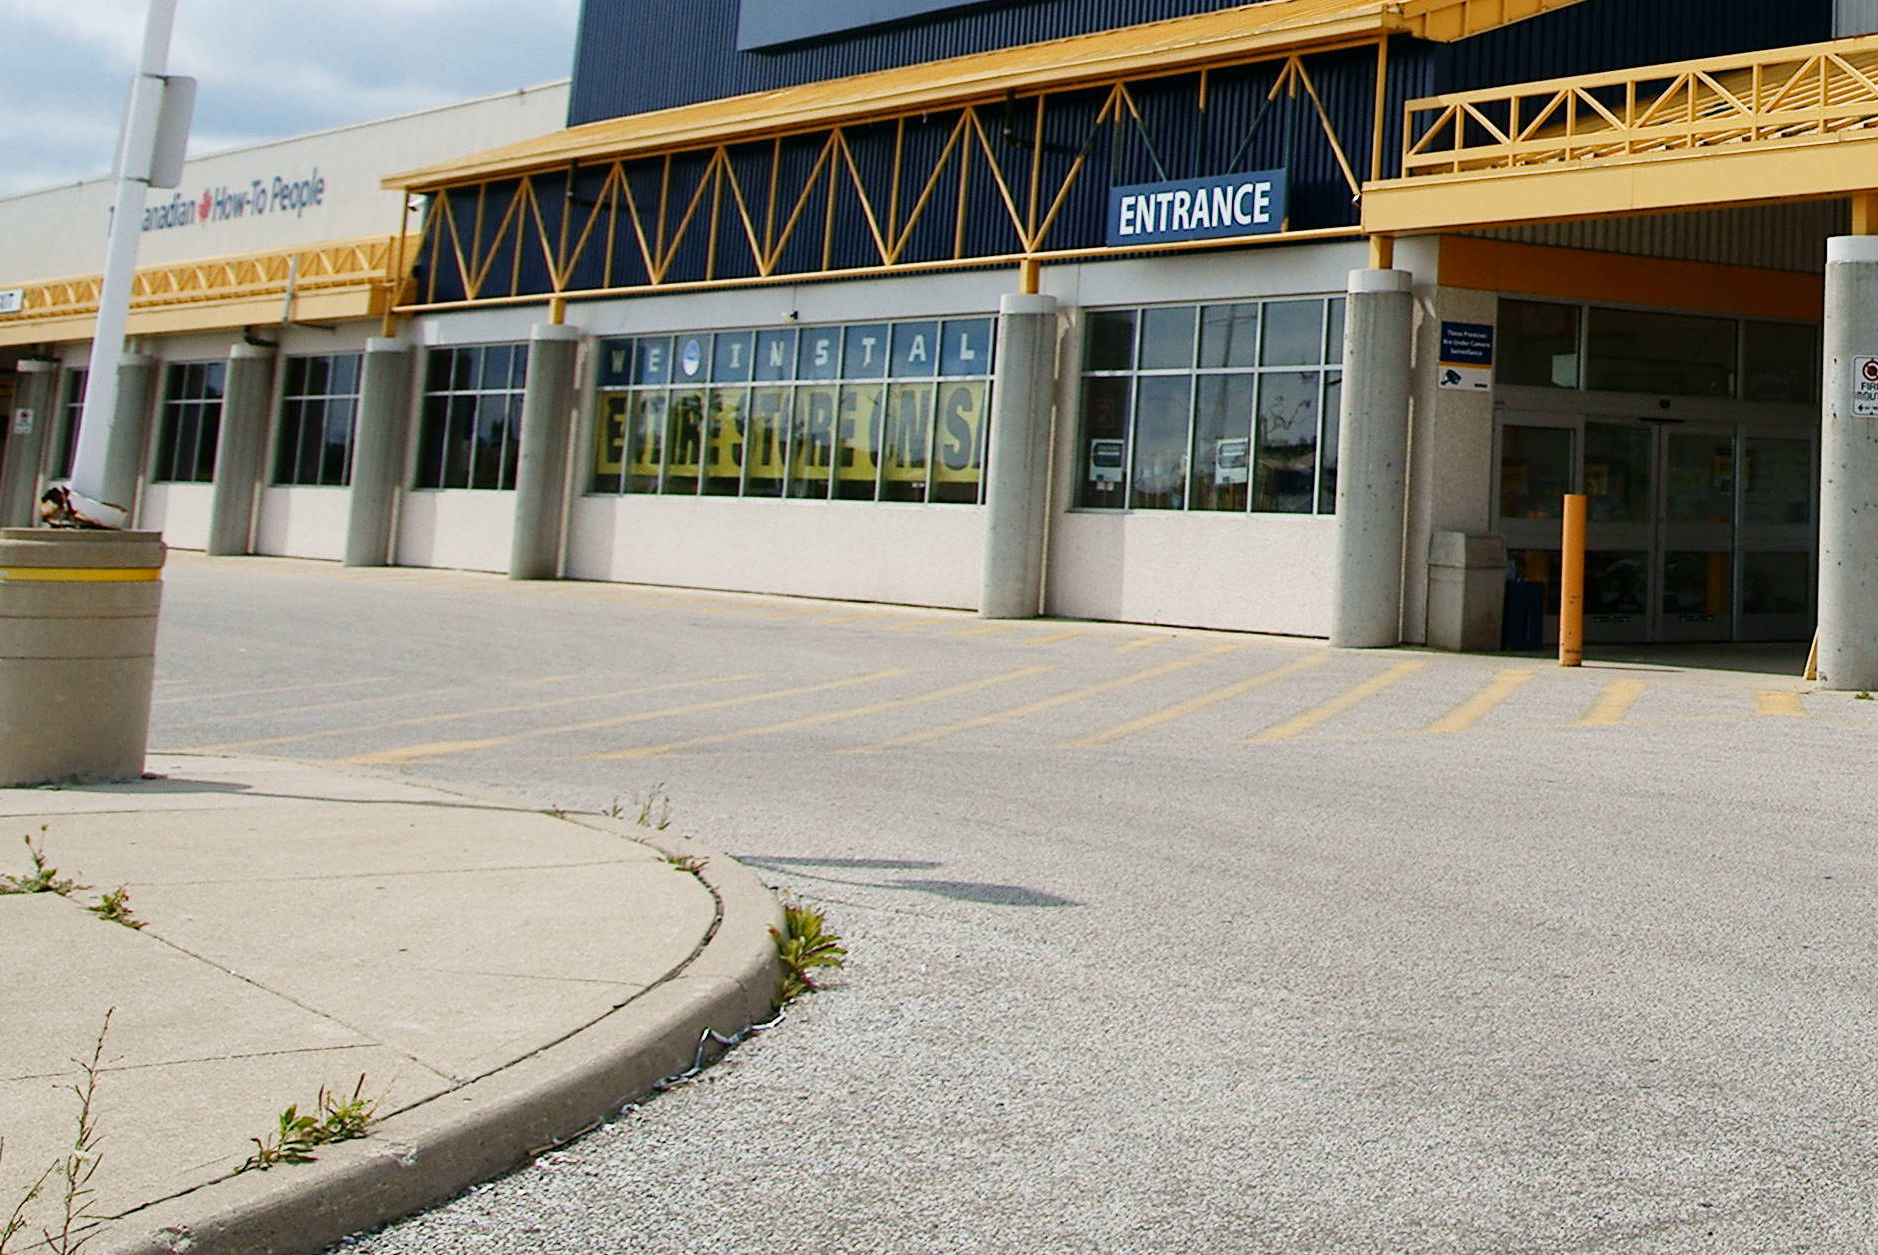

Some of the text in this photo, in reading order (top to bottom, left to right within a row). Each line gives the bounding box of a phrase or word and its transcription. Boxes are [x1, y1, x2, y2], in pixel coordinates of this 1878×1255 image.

[143, 193, 195, 232] anadian
[213, 179, 267, 222] How-To
[270, 166, 325, 218] People
[1118, 181, 1272, 236] ENTRANCE
